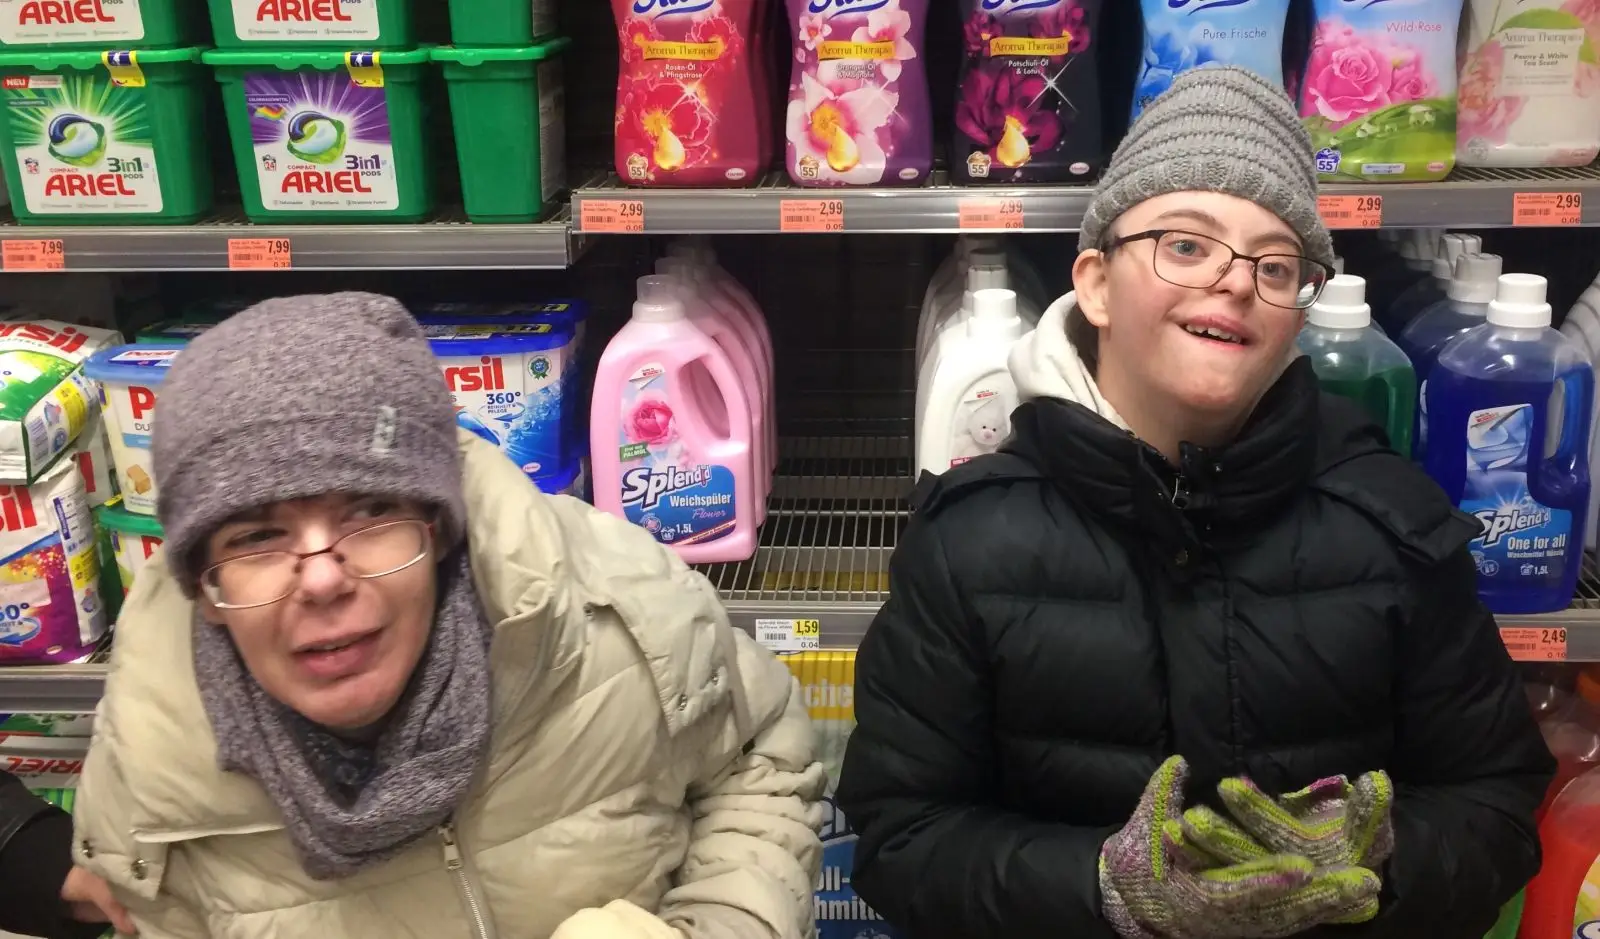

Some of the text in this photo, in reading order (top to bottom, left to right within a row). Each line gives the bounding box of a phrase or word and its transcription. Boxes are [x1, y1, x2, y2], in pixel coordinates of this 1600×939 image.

[19, 0, 115, 25] ARIEL
[256, 0, 352, 21] ARIEL
[1385, 19, 1442, 33] Wild Rose
[1203, 28, 1267, 40] Pure Frische
[646, 45, 717, 56] Aroma Therapie
[822, 45, 852, 55] Aroma
[994, 41, 1065, 53] Aroma Therapie
[665, 62, 696, 71] Rosen-Öl
[6, 78, 25, 86] NEU
[666, 71, 703, 79] Pfingstrose
[107, 157, 144, 173] 3in1
[344, 154, 381, 170] 3in1
[972, 164, 985, 174] 55
[1318, 160, 1333, 171] 55
[630, 166, 643, 176] 55
[802, 166, 815, 177] 55
[45, 173, 136, 197] ARIEL
[281, 171, 372, 193] ARIEL
[820, 202, 843, 216] 2,99
[1000, 200, 1023, 214] 2,99
[1357, 197, 1381, 211] 2,99
[1556, 194, 1581, 210] 2,99
[620, 203, 643, 217] 2,99
[41, 241, 63, 255] 7,99
[267, 240, 290, 255] 7,99
[444, 355, 505, 392] rsil
[486, 391, 522, 405] 360°
[622, 464, 712, 508] Splendid
[669, 493, 732, 508] Weichspüler
[691, 508, 726, 520] Flower
[1507, 533, 1566, 550] One for all
[796, 620, 818, 635] 1,59
[1541, 629, 1567, 644] 2,49
[800, 641, 819, 649] 0.04
